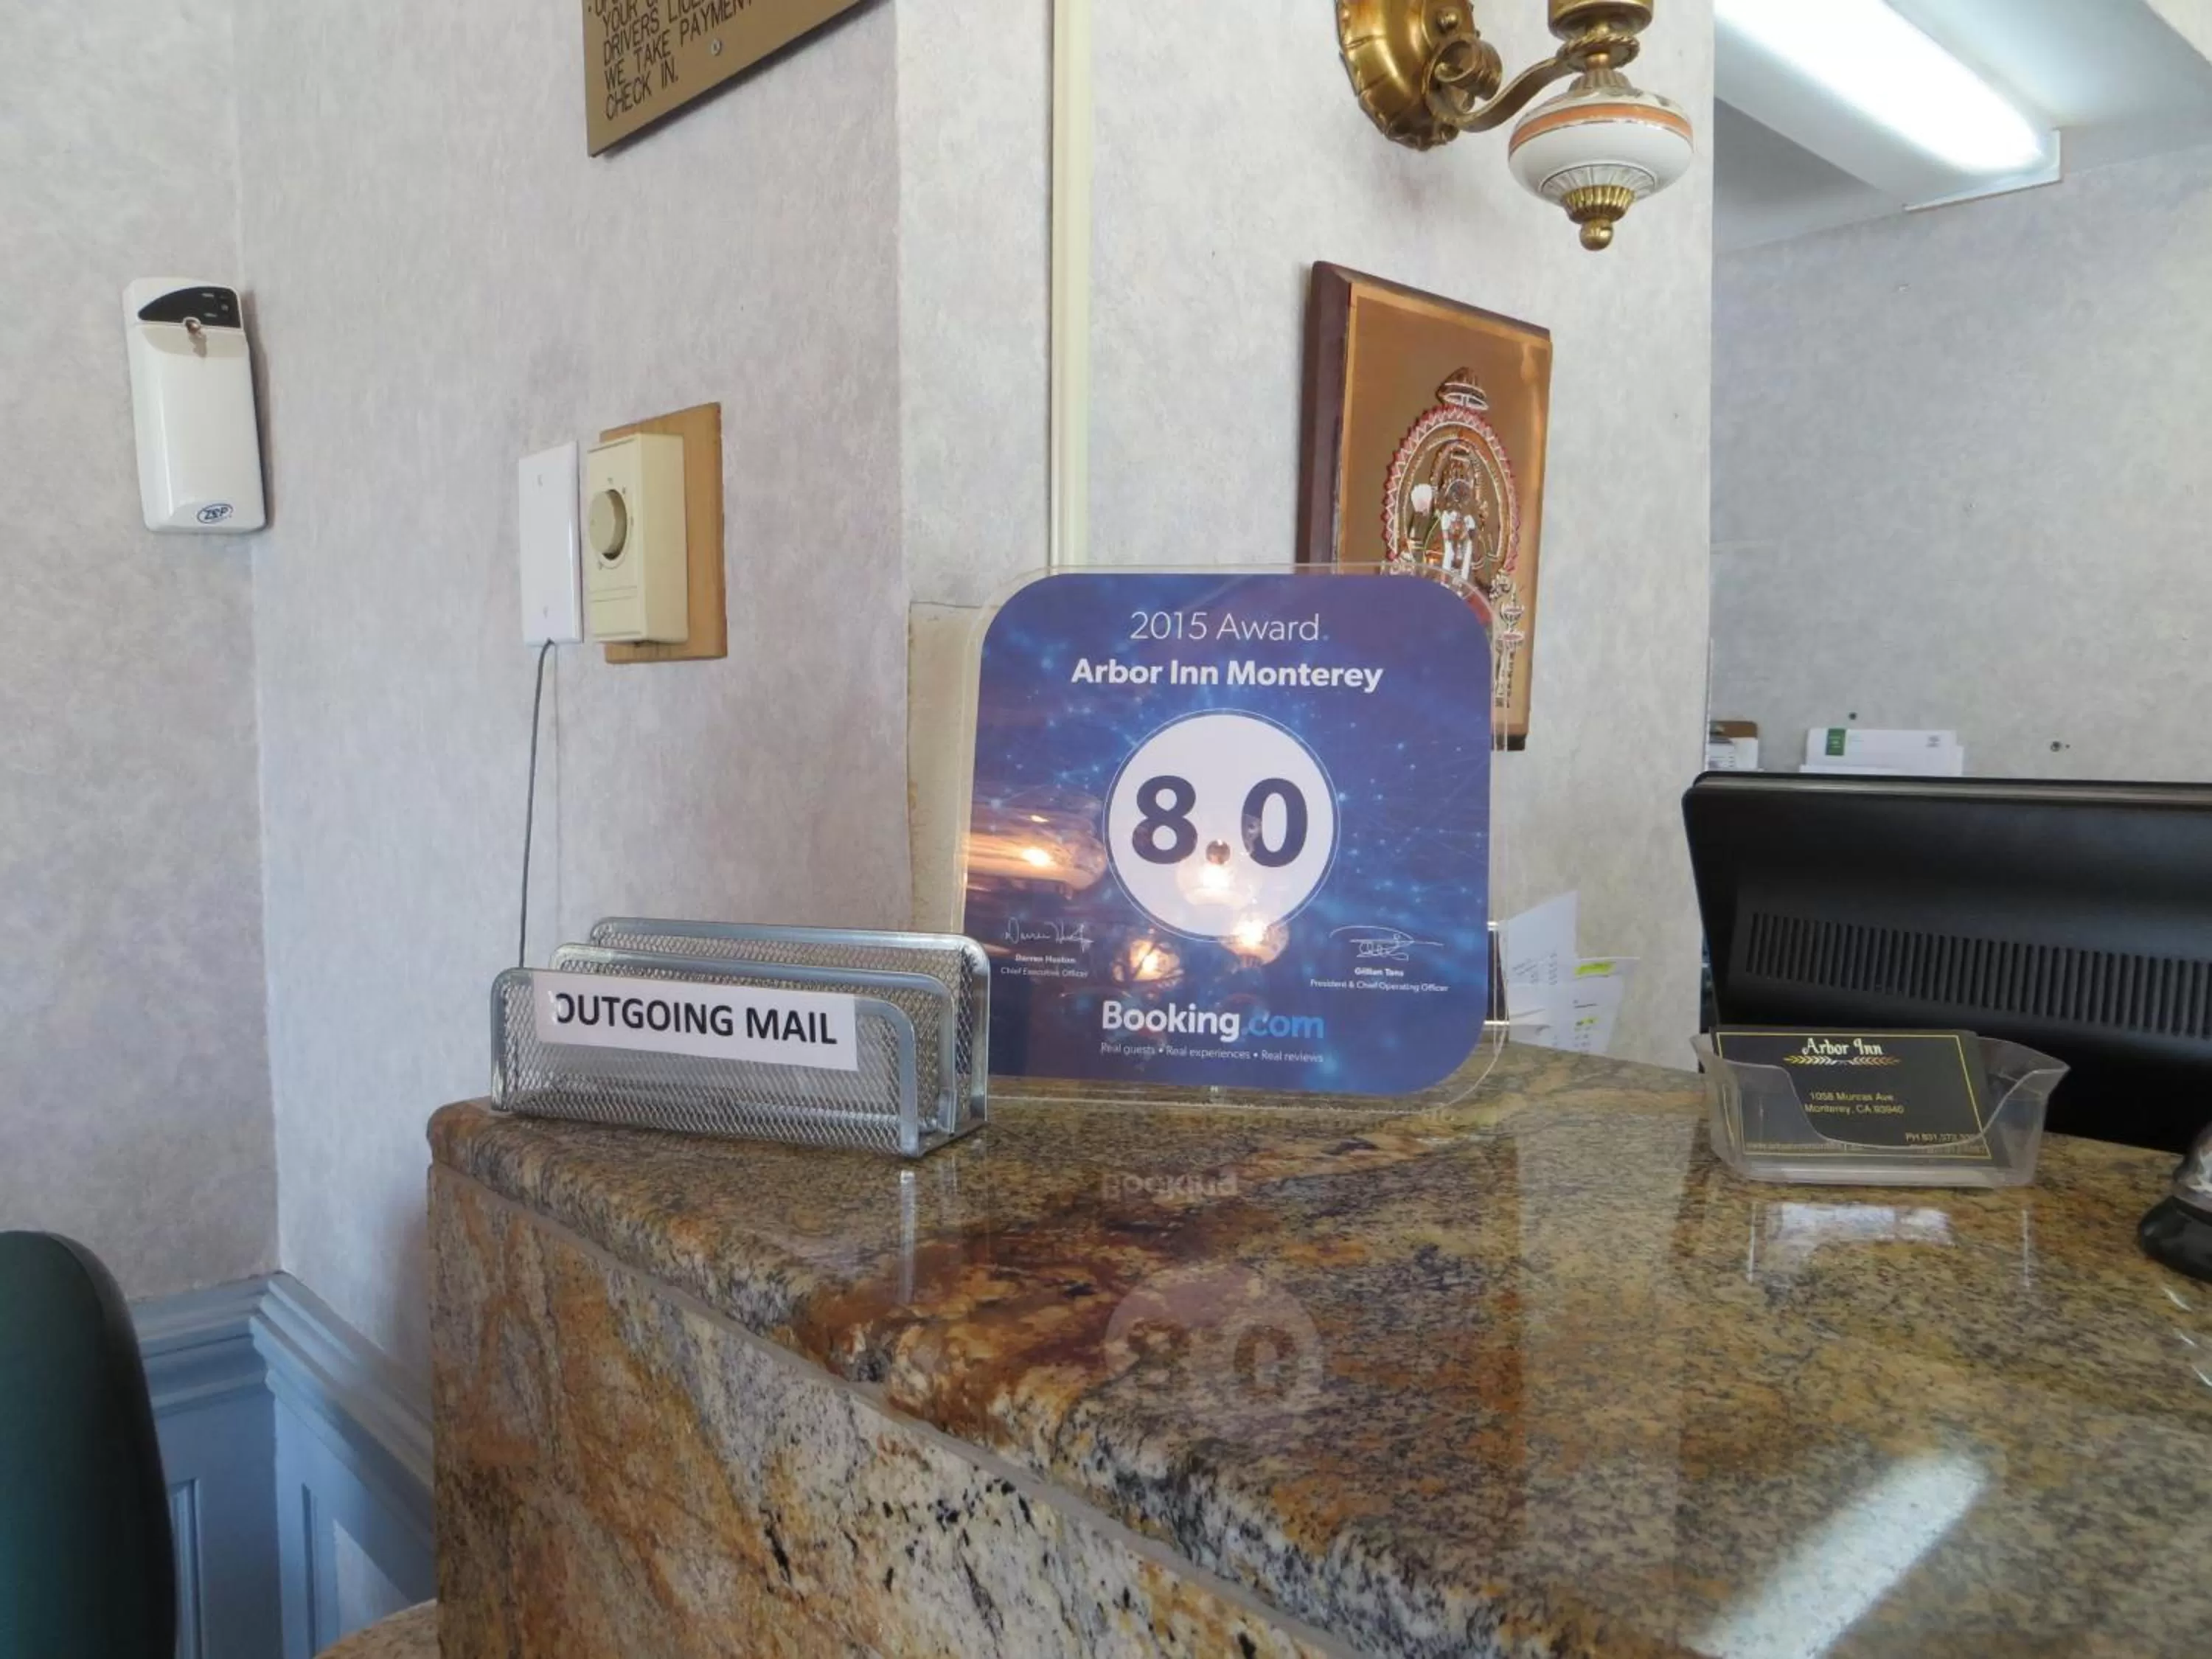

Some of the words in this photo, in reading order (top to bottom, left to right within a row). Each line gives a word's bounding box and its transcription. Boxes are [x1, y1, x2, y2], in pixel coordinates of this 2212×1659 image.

[602, 0, 637, 35] YOUR
[603, 7, 660, 66] DRIVERS
[605, 58, 625, 90] WE
[633, 29, 671, 72] TAKE
[679, 0, 751, 46] PAYMEN
[605, 71, 652, 120] CHECK
[1130, 611, 1208, 641] 2015
[1216, 613, 1320, 641] Award
[1071, 658, 1163, 685] Arbor
[1170, 660, 1219, 686] Inn
[1226, 660, 1383, 693] Monterey
[1132, 775, 1308, 867] 8.0
[553, 992, 734, 1037] OUTGOING
[745, 1006, 838, 1045] MAIL
[1102, 999, 1325, 1043] Booking.com
[1100, 1042, 1121, 1054] Real
[1123, 1043, 1155, 1057] guests
[1166, 1046, 1187, 1057] Real
[1189, 1046, 1251, 1060] experiences
[1262, 1050, 1282, 1062] Real
[1284, 1051, 1324, 1063] reviews
[1801, 1037, 1850, 1056] Arbor
[1852, 1037, 1884, 1056] Inn
